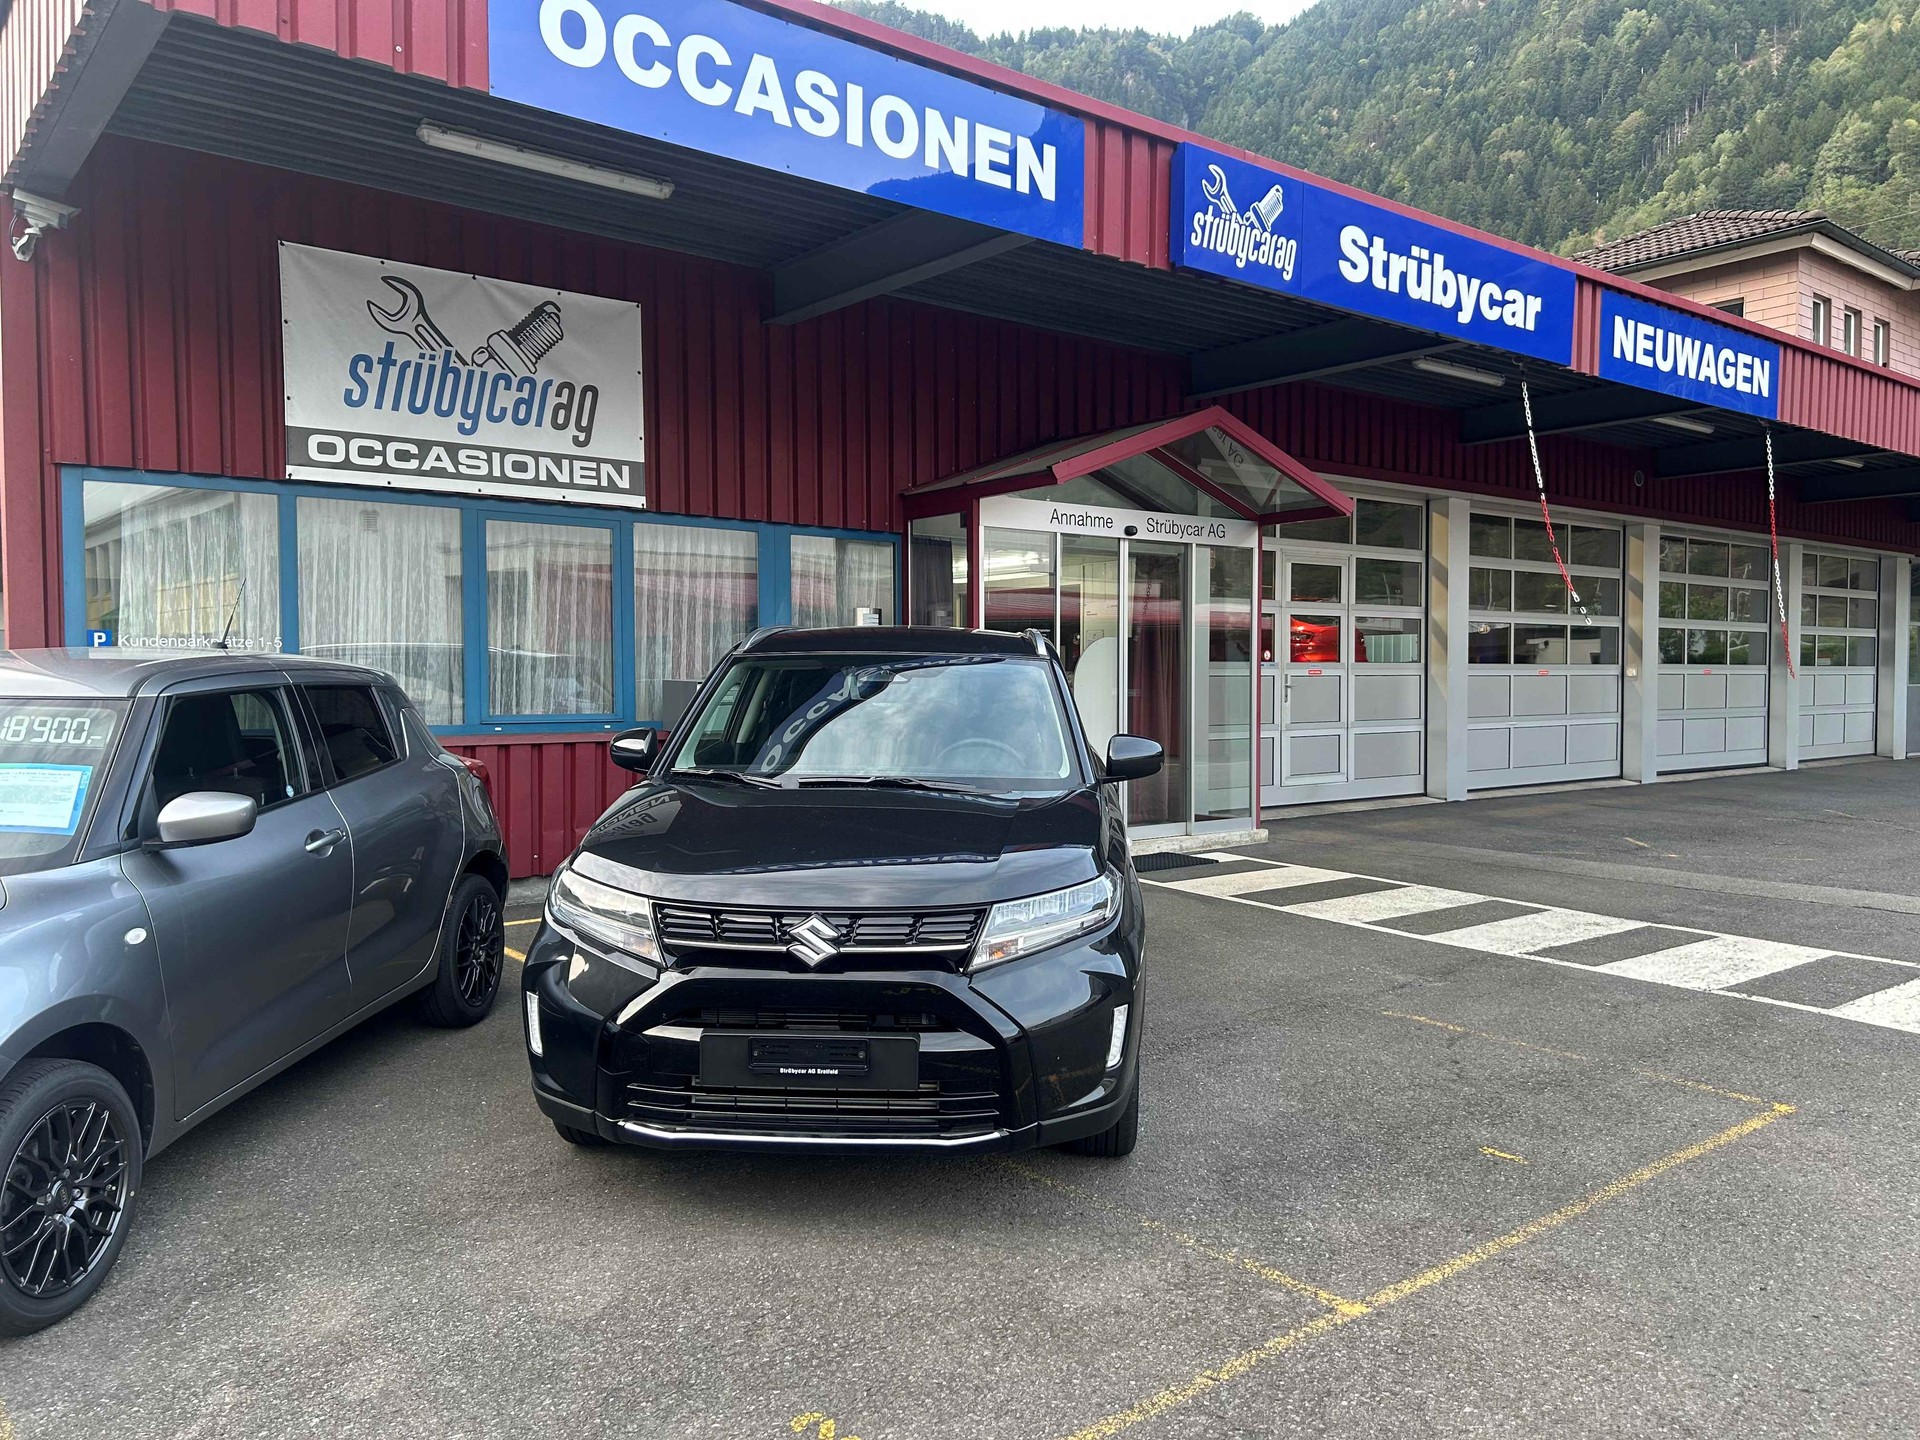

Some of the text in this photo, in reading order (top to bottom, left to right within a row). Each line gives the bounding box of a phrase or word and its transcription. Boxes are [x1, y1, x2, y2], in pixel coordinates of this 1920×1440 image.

[538, 0, 1056, 202] OCCASIONEN
[1338, 225, 1542, 331] Strübycar
[1613, 315, 1770, 398] NEUWAGEN
[307, 434, 630, 489] OCCASIONEN
[1050, 508, 1226, 539] Annahme Strübycar AG
[93, 632, 107, 648] P
[258, 636, 283, 649] 1-5
